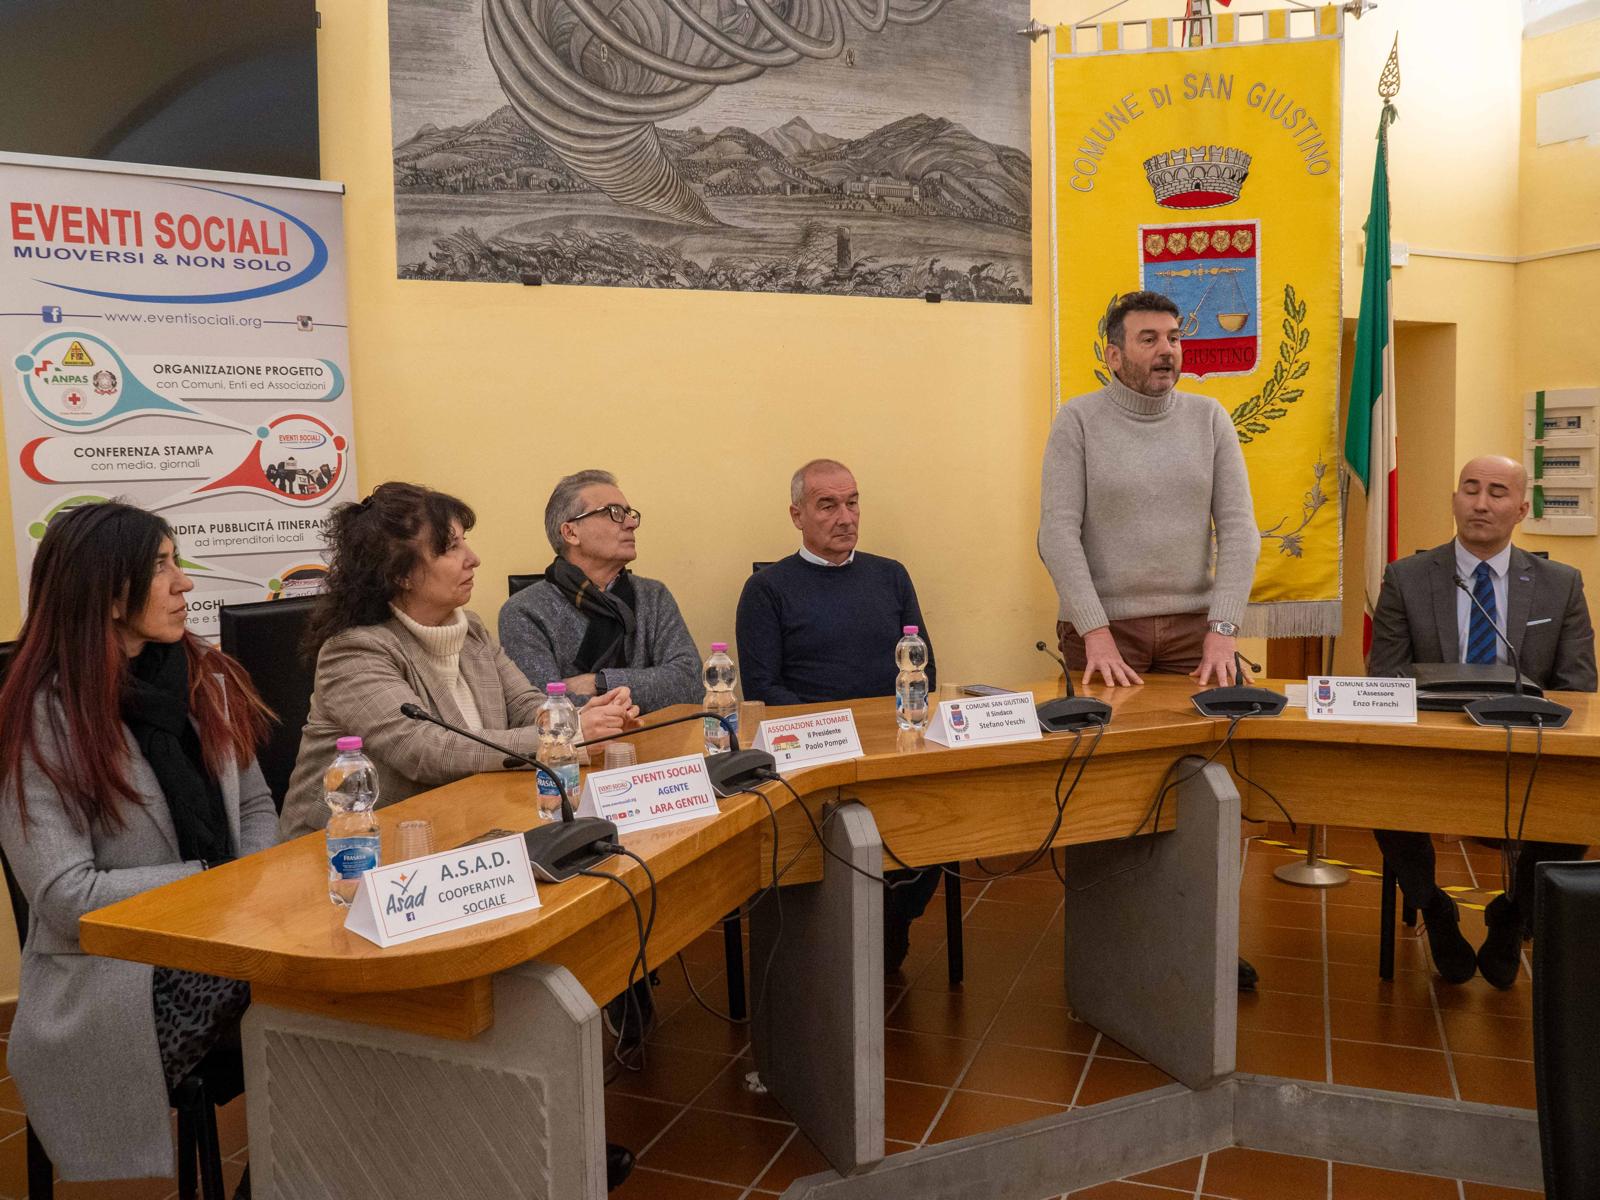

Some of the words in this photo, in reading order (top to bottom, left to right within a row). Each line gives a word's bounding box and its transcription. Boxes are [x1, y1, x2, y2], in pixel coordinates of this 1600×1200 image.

[1070, 93, 1144, 193] COMUNE
[1149, 84, 1172, 109] DI
[1183, 72, 1234, 101] SAN
[1247, 82, 1331, 176] GIUSTINO
[10, 202, 143, 247] EVENTI
[154, 212, 288, 256] SOCIALI
[13, 246, 144, 264] MUOVERSI
[153, 253, 169, 265] &
[176, 254, 226, 269] NON
[233, 258, 291, 272] SOLO
[104, 311, 262, 329] www.eventisociali.org
[1182, 346, 1255, 365] GIUSTINO
[153, 364, 262, 376] ORGANIZZAZIONE
[265, 364, 324, 377] PROGETTO
[51, 375, 89, 384] ANPAS
[156, 381, 179, 389] con
[181, 379, 226, 391] Comuni,
[229, 380, 248, 390] Enti
[250, 380, 265, 390] ed
[267, 381, 326, 391] Associazioni
[73, 446, 160, 458] CONFERENZA
[164, 445, 214, 456] STAMPA
[90, 462, 114, 471] con
[159, 458, 200, 473] giornali
[169, 524, 205, 536] NDITA
[194, 537, 210, 547] ad
[212, 535, 276, 548] imprenditori
[276, 532, 304, 543] locali
[965, 702, 991, 710] COMUNE
[1003, 697, 1030, 707] GIUSTINO
[1371, 700, 1399, 708] Franchi
[991, 709, 1013, 717] Sindaco
[767, 720, 814, 734] ASSOCIAZIONE
[814, 714, 849, 727] ALTOMARE
[979, 719, 1004, 729] Stefano
[1005, 717, 1026, 726] Veschi
[812, 727, 842, 738] Presidente
[805, 741, 823, 751] Paolo
[824, 738, 848, 750] Pompei
[631, 769, 666, 785] EVENTI
[667, 763, 702, 779] SOCIALI
[658, 782, 690, 796] AGENTE
[650, 802, 675, 815] LARA
[675, 794, 709, 810] GENTILI
[440, 851, 511, 881] A.S.A.D.
[438, 874, 515, 903] COOPERATIVA
[386, 885, 427, 915] Asad
[462, 893, 507, 915] SOCIALE
